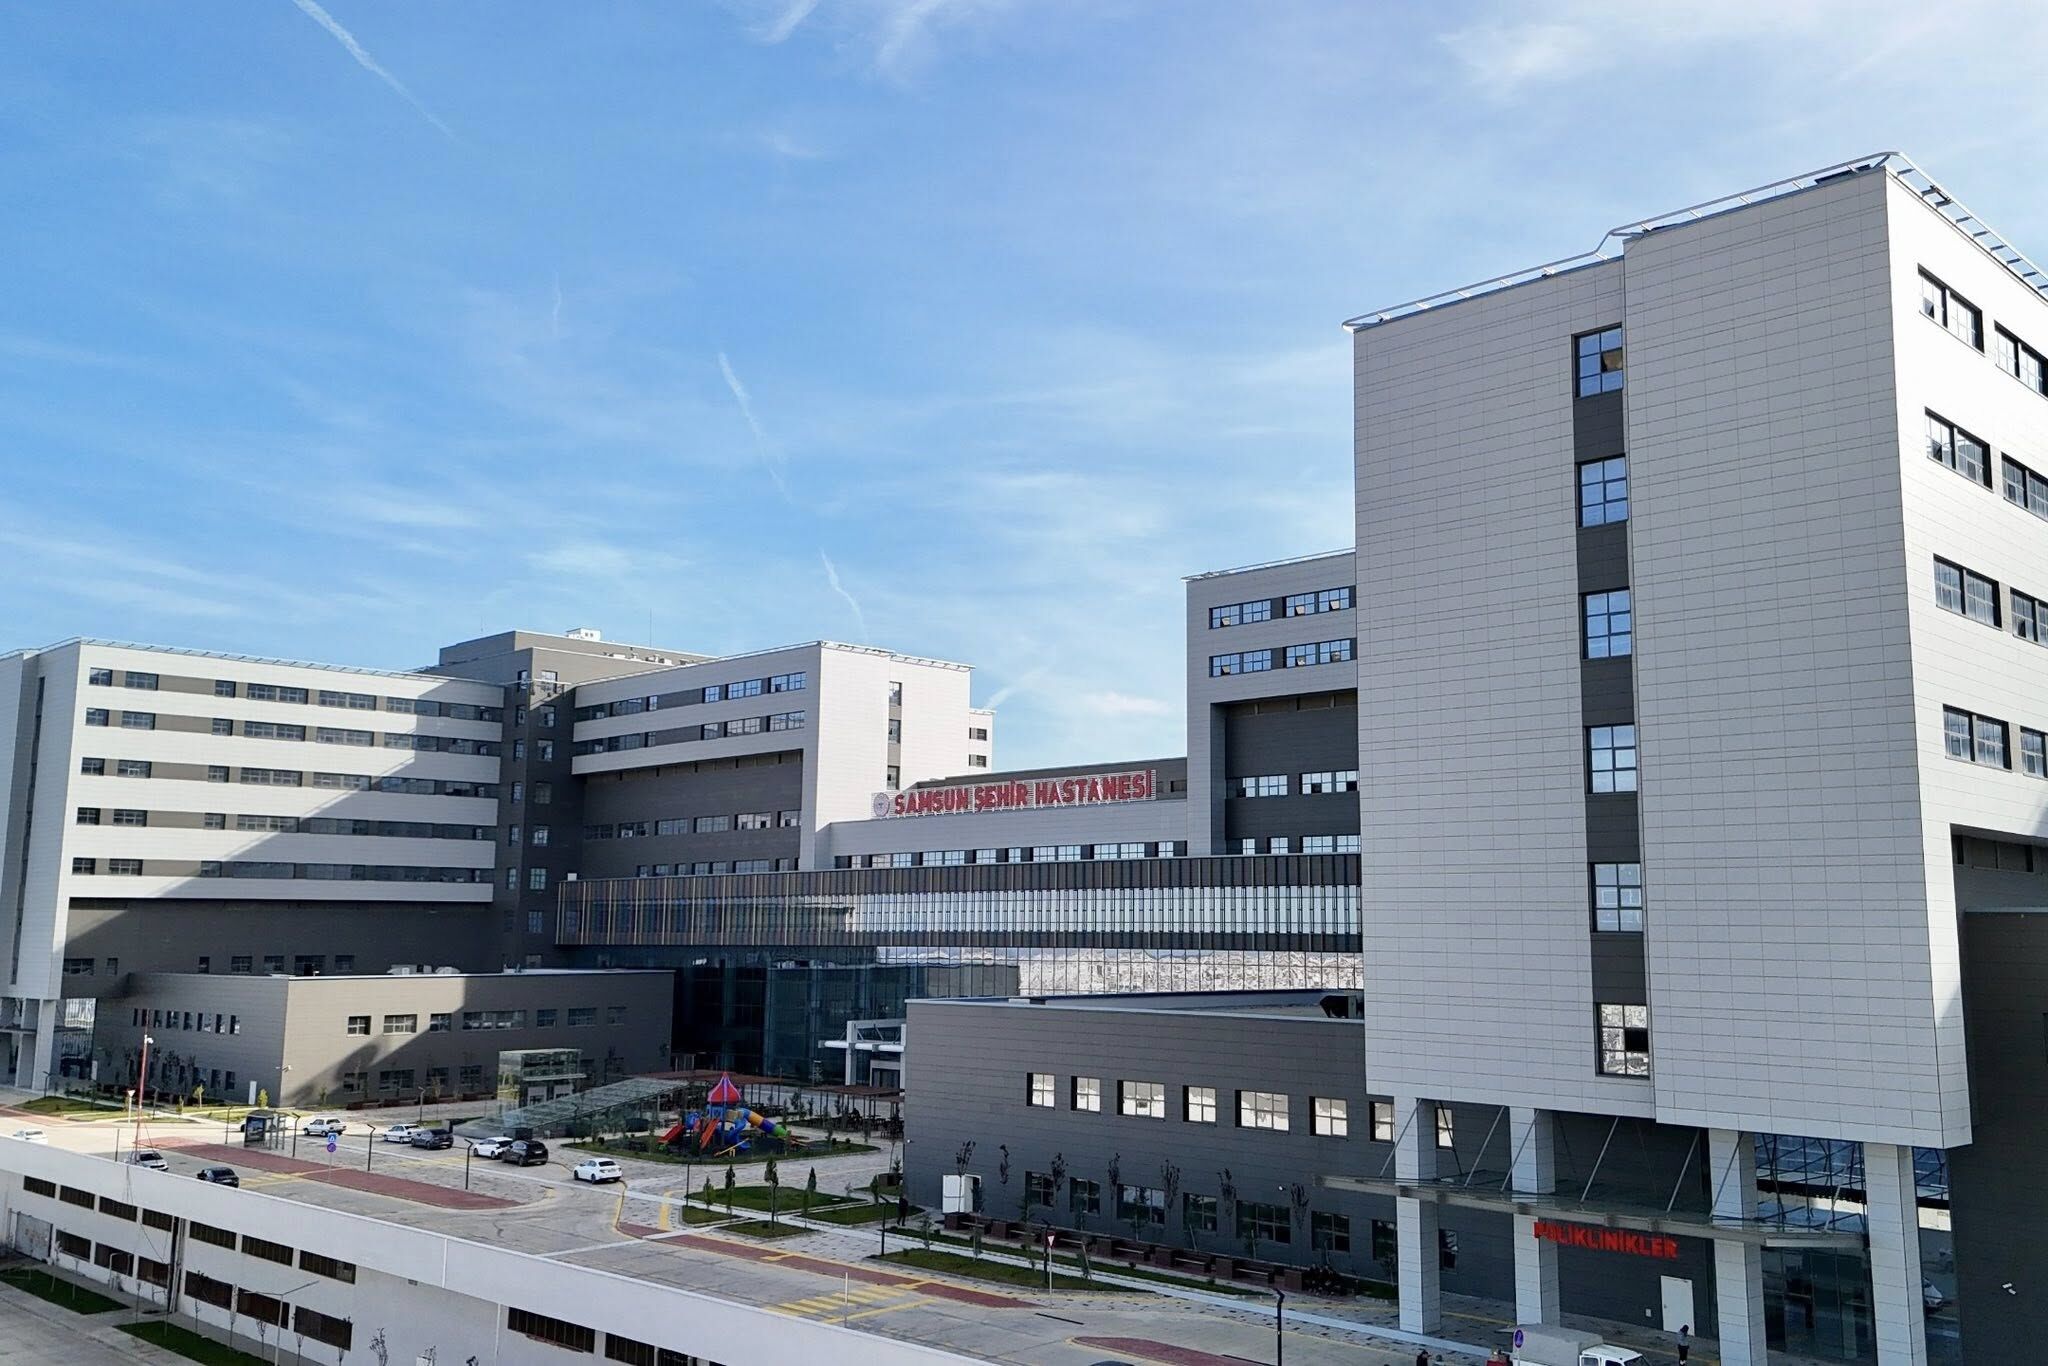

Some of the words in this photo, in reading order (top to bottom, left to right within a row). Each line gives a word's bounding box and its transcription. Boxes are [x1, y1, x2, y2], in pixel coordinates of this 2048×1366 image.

[894, 788, 969, 815] SAMSUN
[974, 779, 1029, 812] ŞEHİR
[1035, 769, 1152, 805] HASTANESİ
